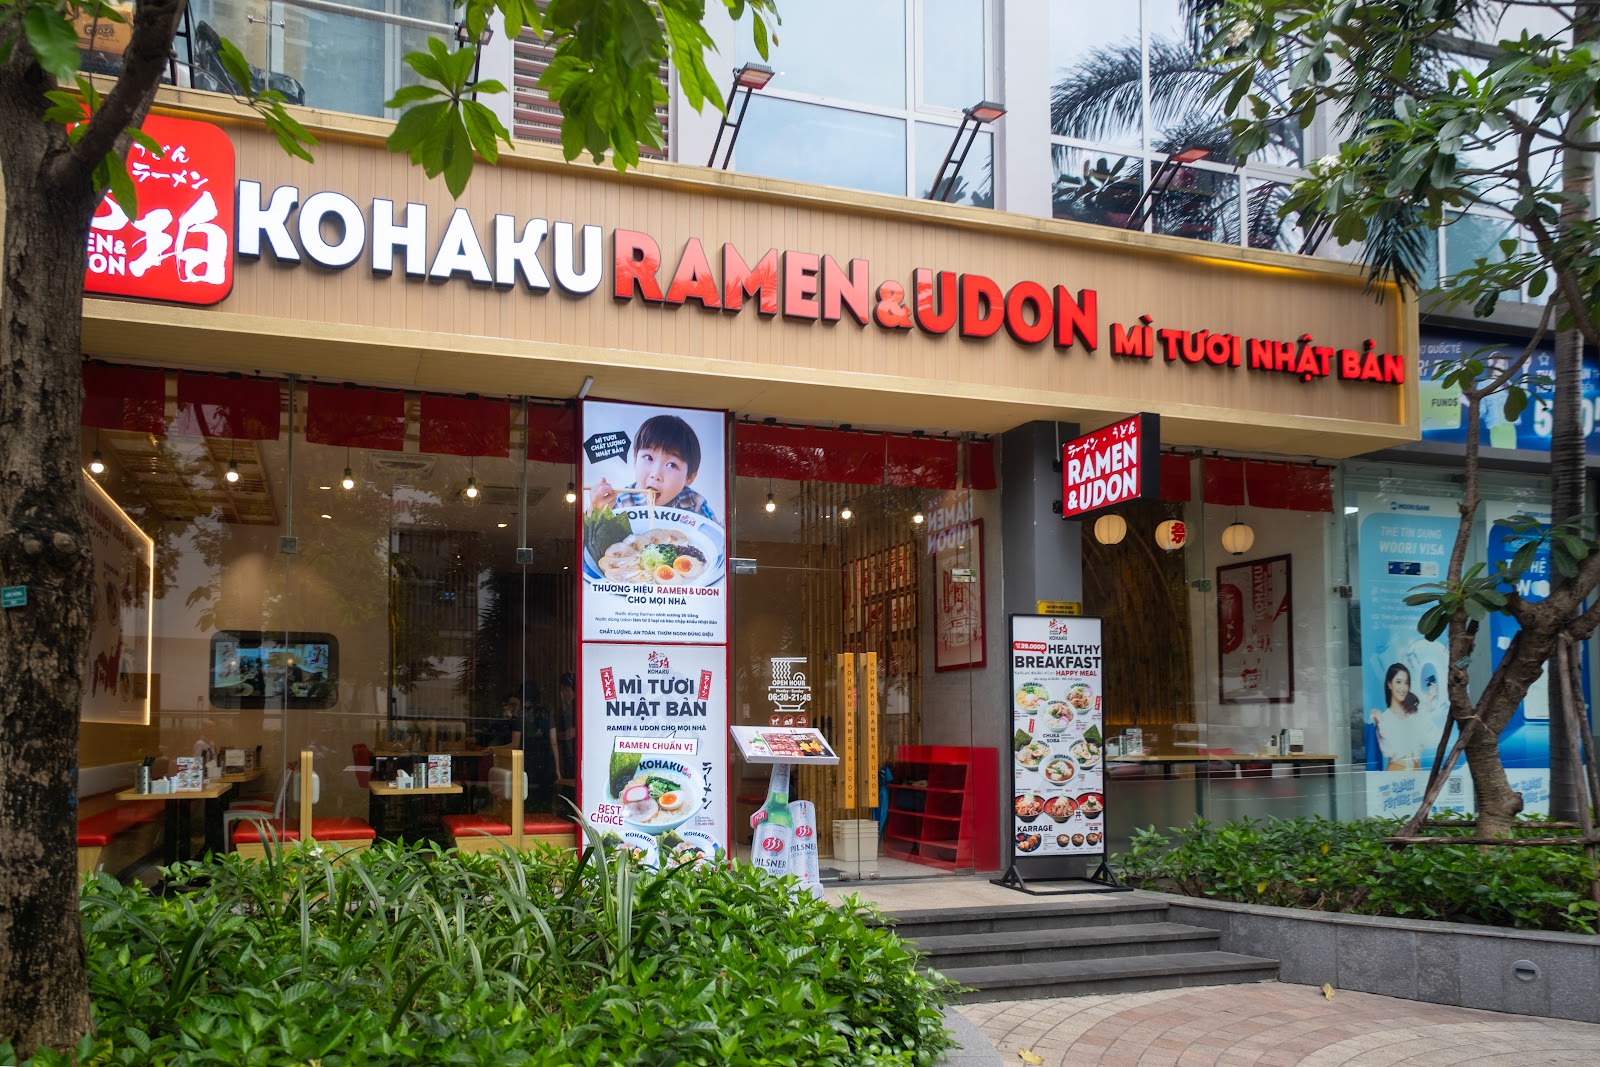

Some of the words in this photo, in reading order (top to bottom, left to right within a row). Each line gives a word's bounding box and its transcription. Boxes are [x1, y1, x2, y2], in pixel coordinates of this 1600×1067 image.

[132, 162, 209, 190] ラーメン
[237, 179, 604, 297] KOHAKU
[1110, 314, 1154, 359] MÌ
[1157, 329, 1242, 368] TƯƠI
[1246, 333, 1335, 383] NHẬT
[1337, 338, 1405, 385] BẢN
[1431, 398, 1459, 408] FUNDS
[1067, 436, 1137, 487] RAMEN
[616, 510, 682, 522] OHAKU
[1378, 540, 1417, 554] WOORI
[1419, 542, 1445, 556] VISA
[632, 582, 654, 595] HIỆU
[656, 586, 689, 595] RAMEN
[695, 587, 720, 596] UDON
[627, 596, 647, 604] CHO
[649, 596, 666, 607] MỌI
[668, 595, 687, 606] NHÀ
[1048, 644, 1101, 655] HEALTHY
[1014, 655, 1101, 669] BREAKFAST
[603, 671, 613, 697] うどん
[619, 674, 642, 695] MÌ
[647, 676, 695, 695] TƯƠI
[768, 693, 812, 701] 06:30-21:45
[606, 696, 660, 721] NHẬT
[666, 696, 707, 717] BẢN
[677, 725, 691, 733] MỌI
[691, 724, 707, 732] NHÀ
[619, 741, 651, 750] RAMEN
[684, 743, 694, 753] VỊ
[639, 759, 684, 773] KOHAKU
[702, 761, 713, 810] ラーメン
[598, 803, 622, 815] BEST
[590, 813, 624, 826] CHOICE
[1017, 824, 1053, 833] KARRAGE
[625, 832, 652, 843] KOHAKU
[683, 831, 709, 840] KOHAKU
[754, 858, 787, 869] PILSNER
